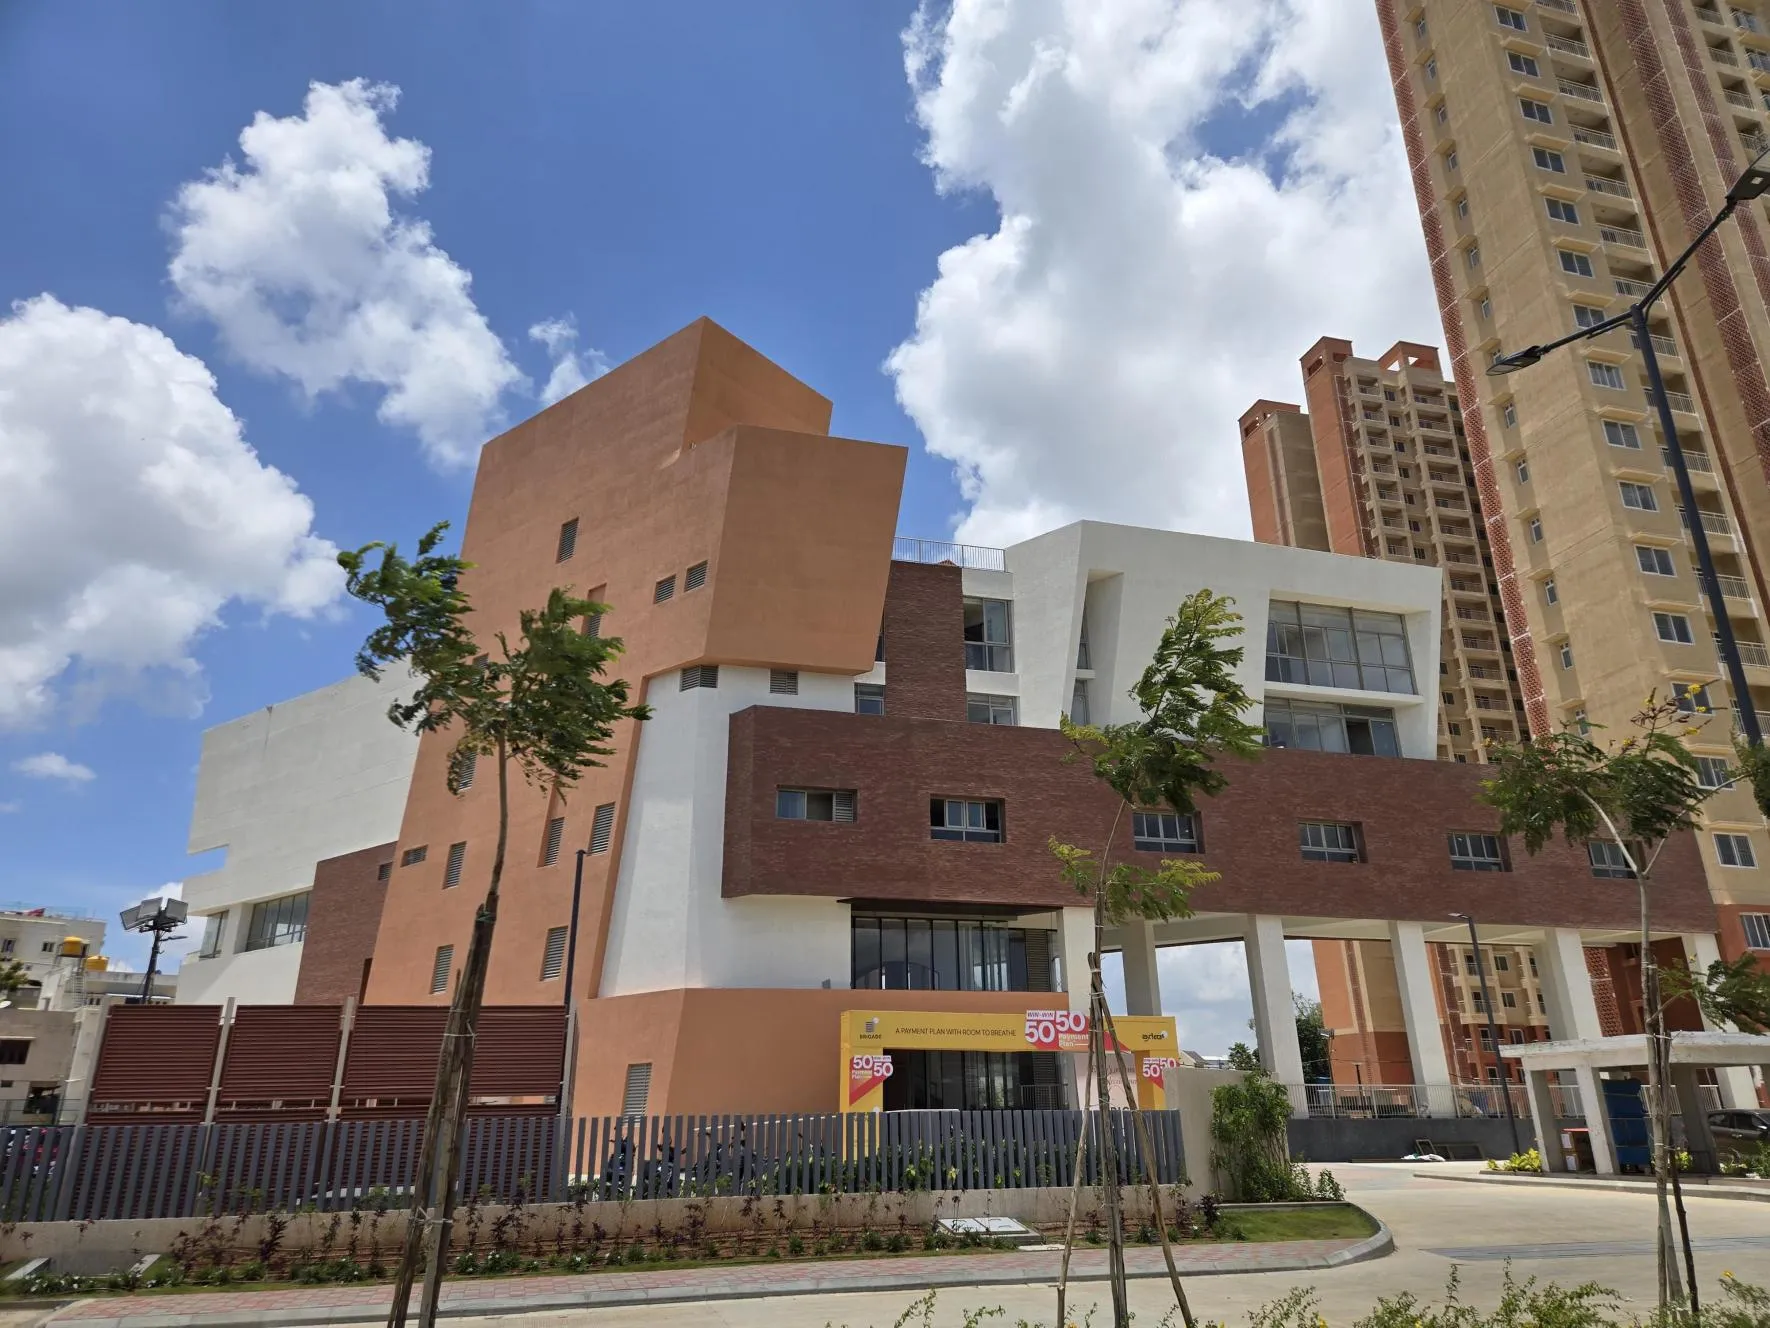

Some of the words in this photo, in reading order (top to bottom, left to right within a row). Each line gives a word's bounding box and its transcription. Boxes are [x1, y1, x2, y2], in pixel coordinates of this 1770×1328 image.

[1056, 1010, 1086, 1032] 50
[991, 1028, 1016, 1036] BREATHE
[1025, 1021, 1055, 1043] 50
[853, 1055, 873, 1069] 50
[873, 1062, 894, 1077] 50
[1143, 1064, 1161, 1077] 50
